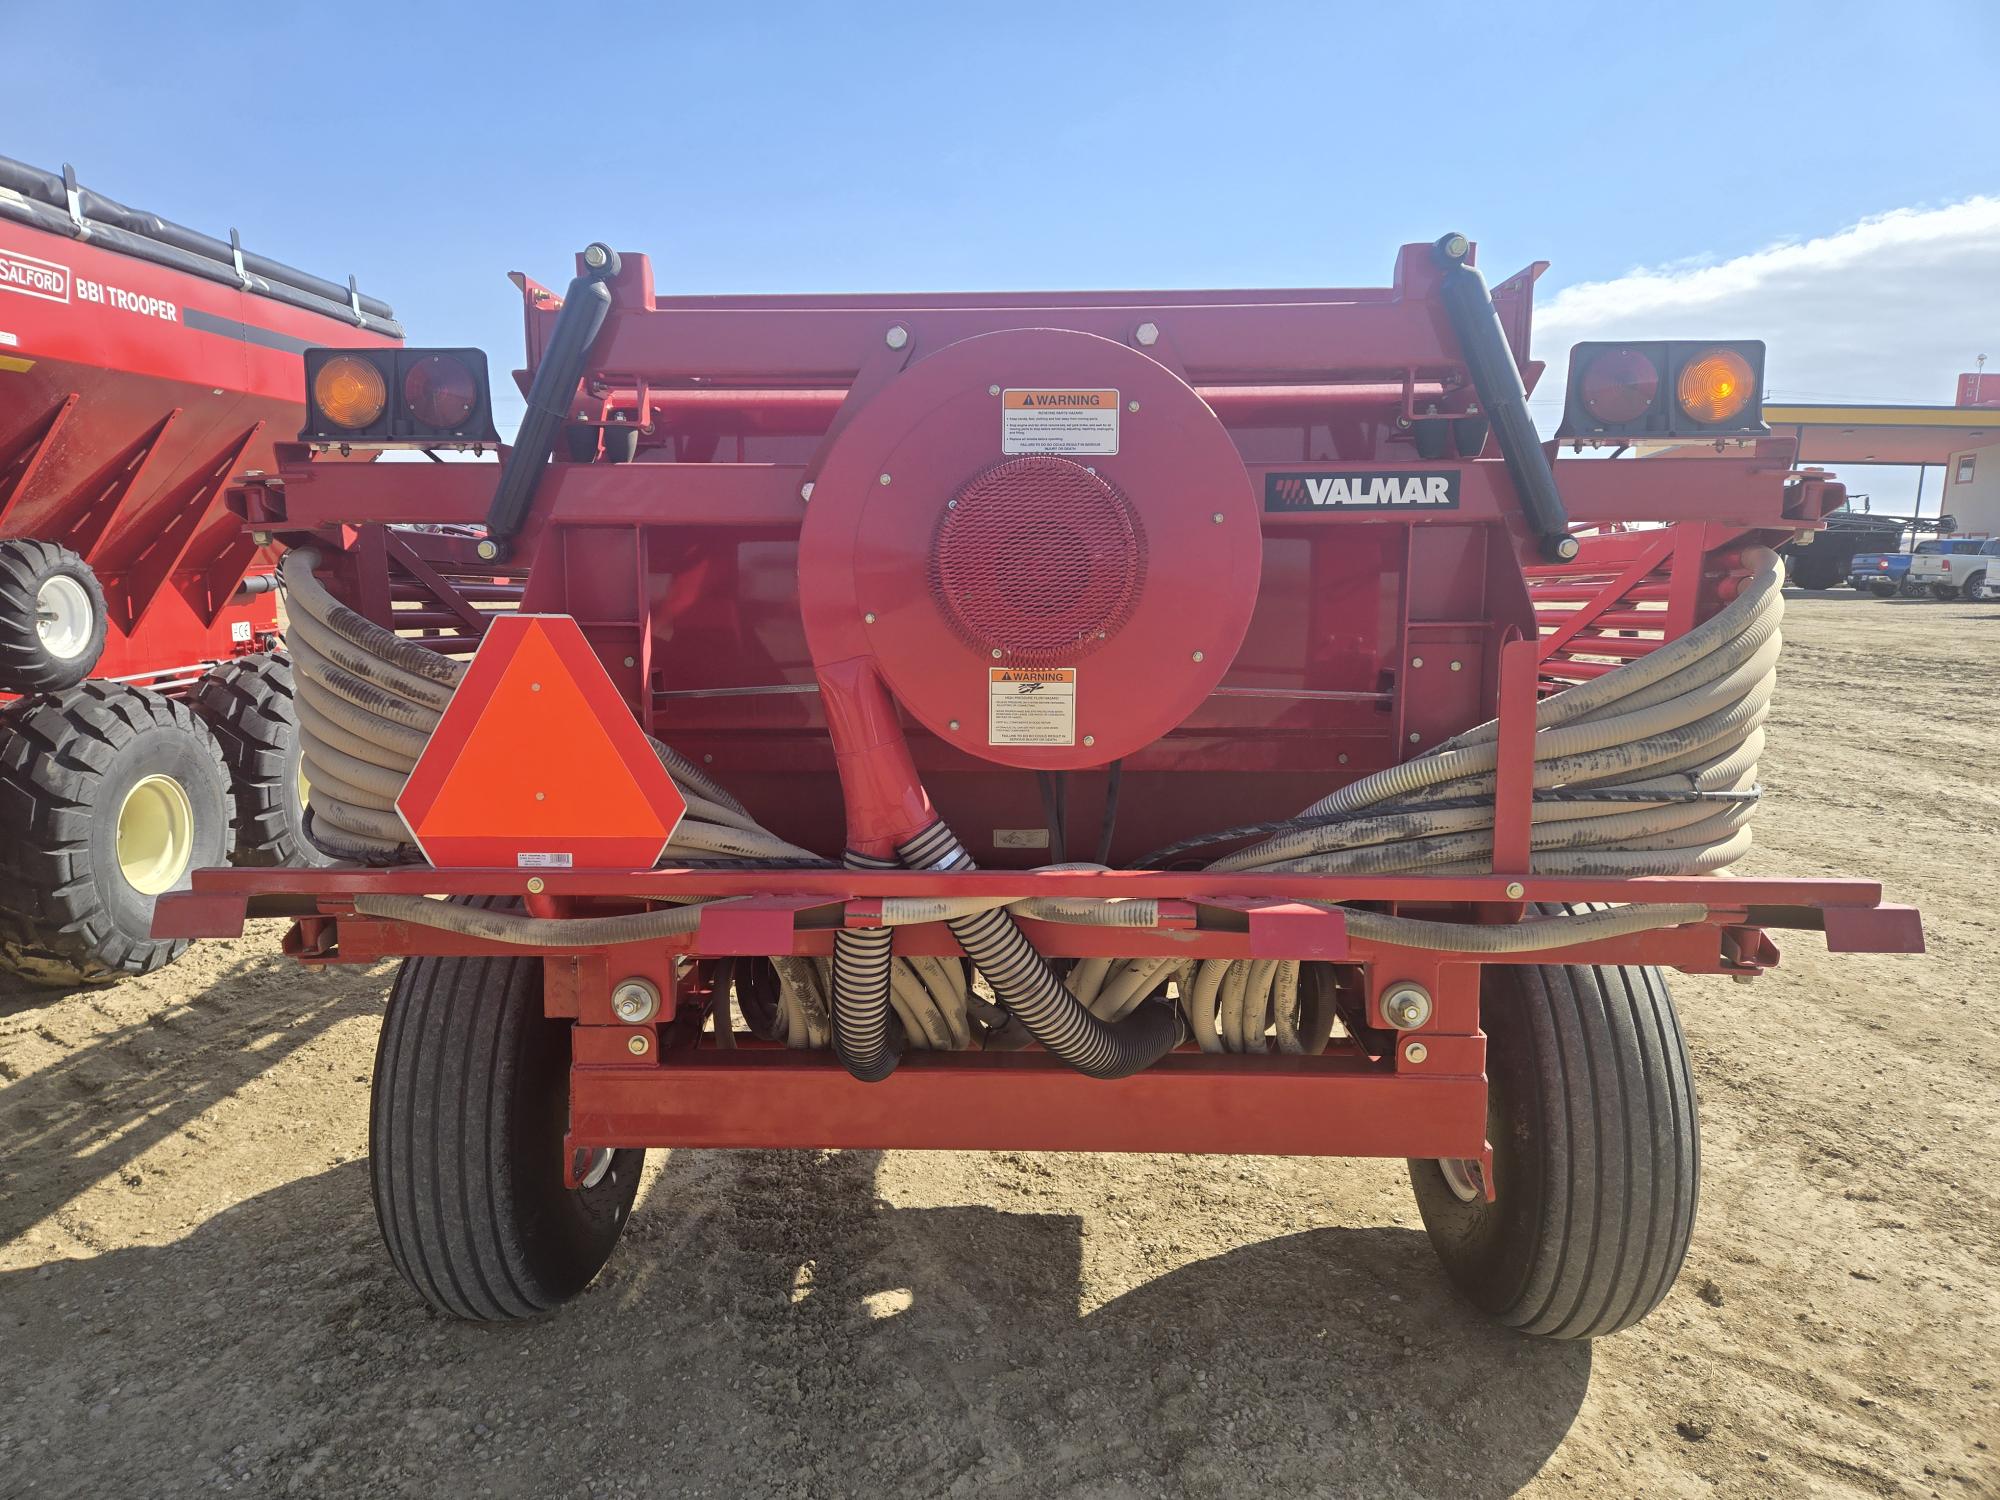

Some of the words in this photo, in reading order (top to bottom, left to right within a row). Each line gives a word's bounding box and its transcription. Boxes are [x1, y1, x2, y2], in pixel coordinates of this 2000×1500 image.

[0, 259, 64, 293] SALFORD
[75, 277, 105, 304] BBI
[106, 285, 177, 322] TROOPER
[1036, 395, 1100, 406] WARNING
[1305, 476, 1450, 505] VALMAR
[1013, 672, 1064, 681] WARNING
